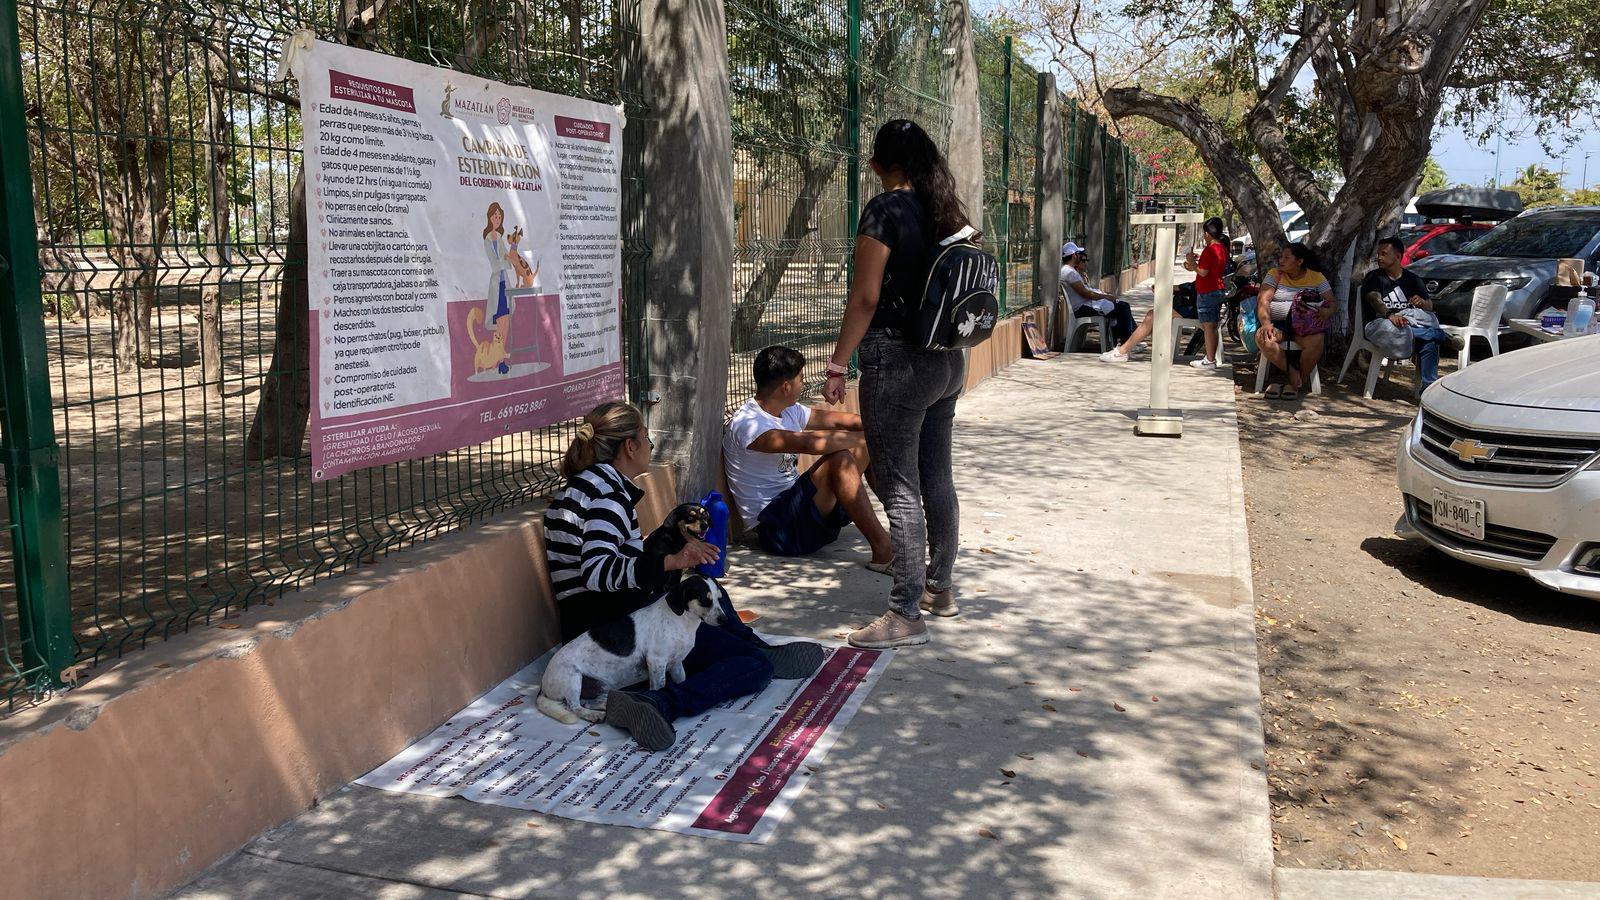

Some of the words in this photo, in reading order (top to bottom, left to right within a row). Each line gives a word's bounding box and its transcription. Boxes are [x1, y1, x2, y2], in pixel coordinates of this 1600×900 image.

[348, 80, 381, 94] REQUISITOS
[381, 87, 397, 97] PARA
[334, 86, 371, 101] ESTERILIZAR
[372, 93, 377, 102] A
[377, 94, 385, 103] TU
[386, 96, 413, 109] MASCOTA
[320, 104, 342, 115] Edad
[342, 106, 352, 116] de
[353, 107, 358, 116] 4
[359, 110, 378, 120] meses
[455, 99, 494, 114] MAZATLÁN
[320, 120, 346, 130] perras
[348, 122, 361, 132] que
[363, 124, 381, 133] pesen
[382, 125, 394, 135] más
[395, 127, 402, 136] de
[320, 132, 329, 141] 20
[330, 132, 340, 144] kg
[342, 135, 364, 145] como
[321, 146, 340, 156] Edad
[341, 148, 352, 157] de
[352, 149, 358, 158] 4
[360, 151, 381, 160] meses
[463, 137, 513, 158] CAMPAÑA
[514, 145, 528, 159] DE
[322, 160, 341, 170] gatos
[342, 163, 358, 172] que
[359, 164, 381, 173] pesen
[383, 165, 394, 174] más
[395, 166, 403, 174] de
[458, 156, 540, 179] ESTERILIZACIÓN
[323, 174, 344, 185] Ayuno
[345, 175, 355, 184] de
[356, 176, 364, 185] 12
[365, 177, 377, 186] hrs
[408, 180, 432, 191] comida)
[460, 176, 472, 186] DEL
[473, 177, 504, 188] GOBIERNO
[505, 179, 511, 188] DE
[513, 180, 542, 192] MAZATLÁN
[352, 190, 363, 198] sin
[364, 191, 390, 200] pulgas
[325, 201, 334, 210] No
[335, 204, 356, 212] perras
[367, 203, 384, 212] celo
[329, 228, 339, 237] No
[339, 229, 366, 237] animales
[329, 242, 348, 250] Llevar
[366, 254, 392, 265] después
[394, 254, 403, 263] de
[404, 254, 410, 262] la
[330, 269, 347, 277] Traer
[361, 267, 387, 276] mascota
[333, 282, 346, 292] caja
[394, 280, 413, 290] jabas
[334, 295, 354, 304] Perros
[395, 292, 413, 301] bozal
[414, 294, 418, 302] y
[334, 308, 360, 318] Machos
[372, 306, 380, 315] los
[381, 305, 391, 314] dos
[392, 303, 424, 314] testículos
[334, 335, 346, 344] No
[347, 335, 367, 345] perros
[368, 332, 387, 341] chatos
[334, 350, 344, 359] ya
[345, 349, 358, 358] que
[360, 346, 387, 356] requieren
[388, 343, 400, 352] otro
[400, 342, 410, 352] tipo
[411, 341, 420, 349] de
[335, 371, 381, 384] Compromiso
[382, 369, 389, 378] de
[390, 365, 417, 377] cuidados
[334, 394, 382, 410] Identificación
[480, 410, 496, 423] TEL.
[497, 406, 513, 420] 669
[514, 403, 529, 418] 952
[322, 428, 365, 443] ESTERILIZAR
[367, 424, 389, 435] AYUDA
[375, 433, 391, 443] CELO
[397, 428, 418, 439] ACOSO
[419, 423, 441, 434] SEXUAL
[1434, 499, 1480, 528] VSN-840-C
